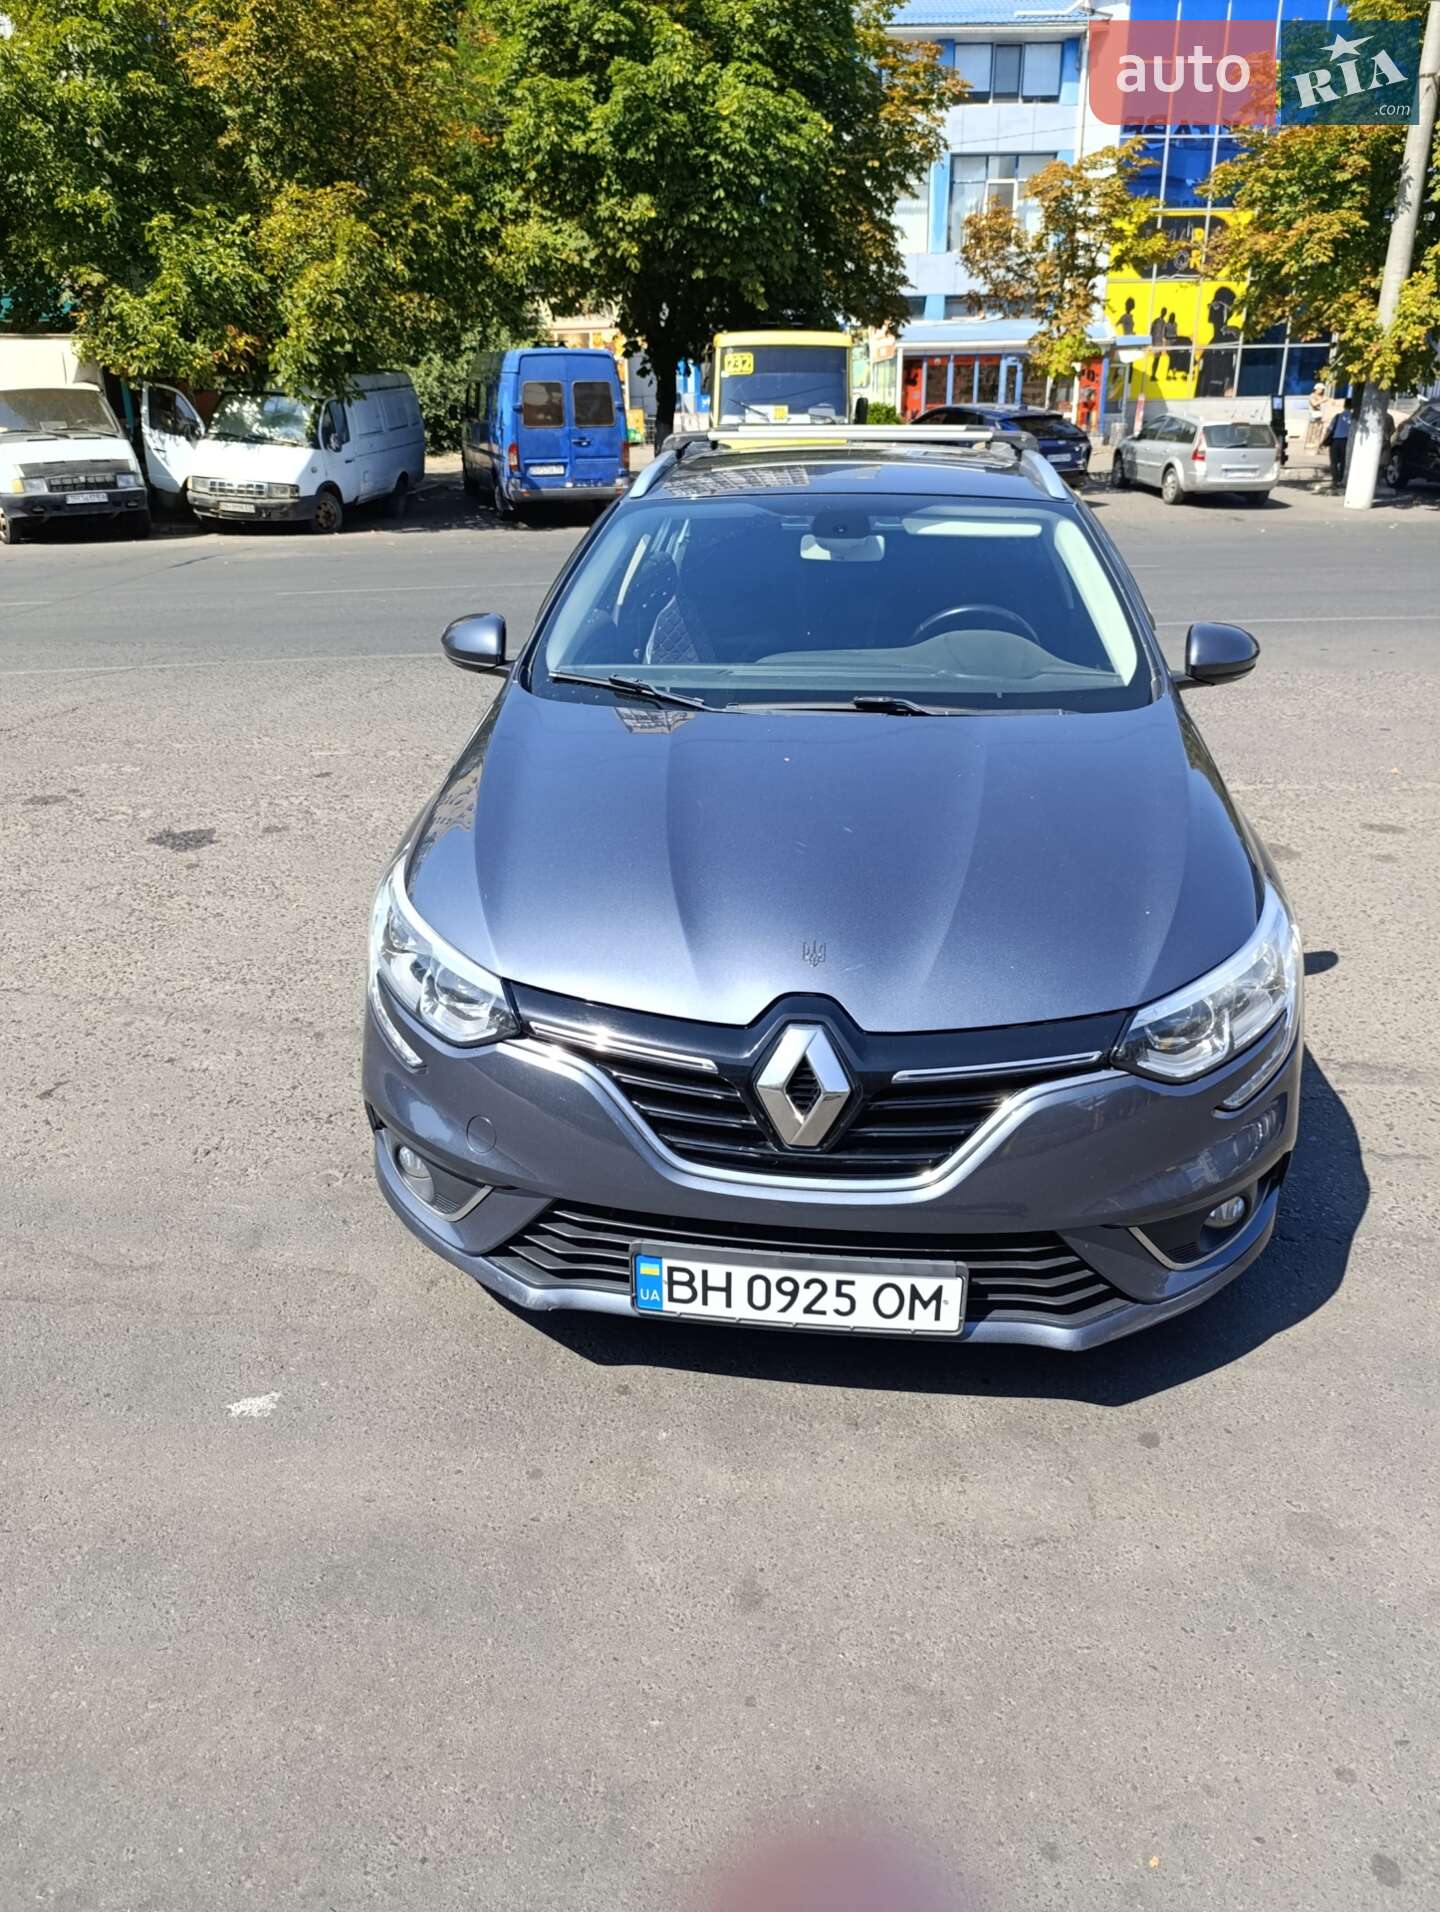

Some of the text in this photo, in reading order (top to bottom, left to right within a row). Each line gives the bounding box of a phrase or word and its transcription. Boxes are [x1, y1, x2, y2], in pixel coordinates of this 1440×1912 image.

[640, 1288, 660, 1302] UA
[666, 1266, 943, 1322] BH 0925 OM
